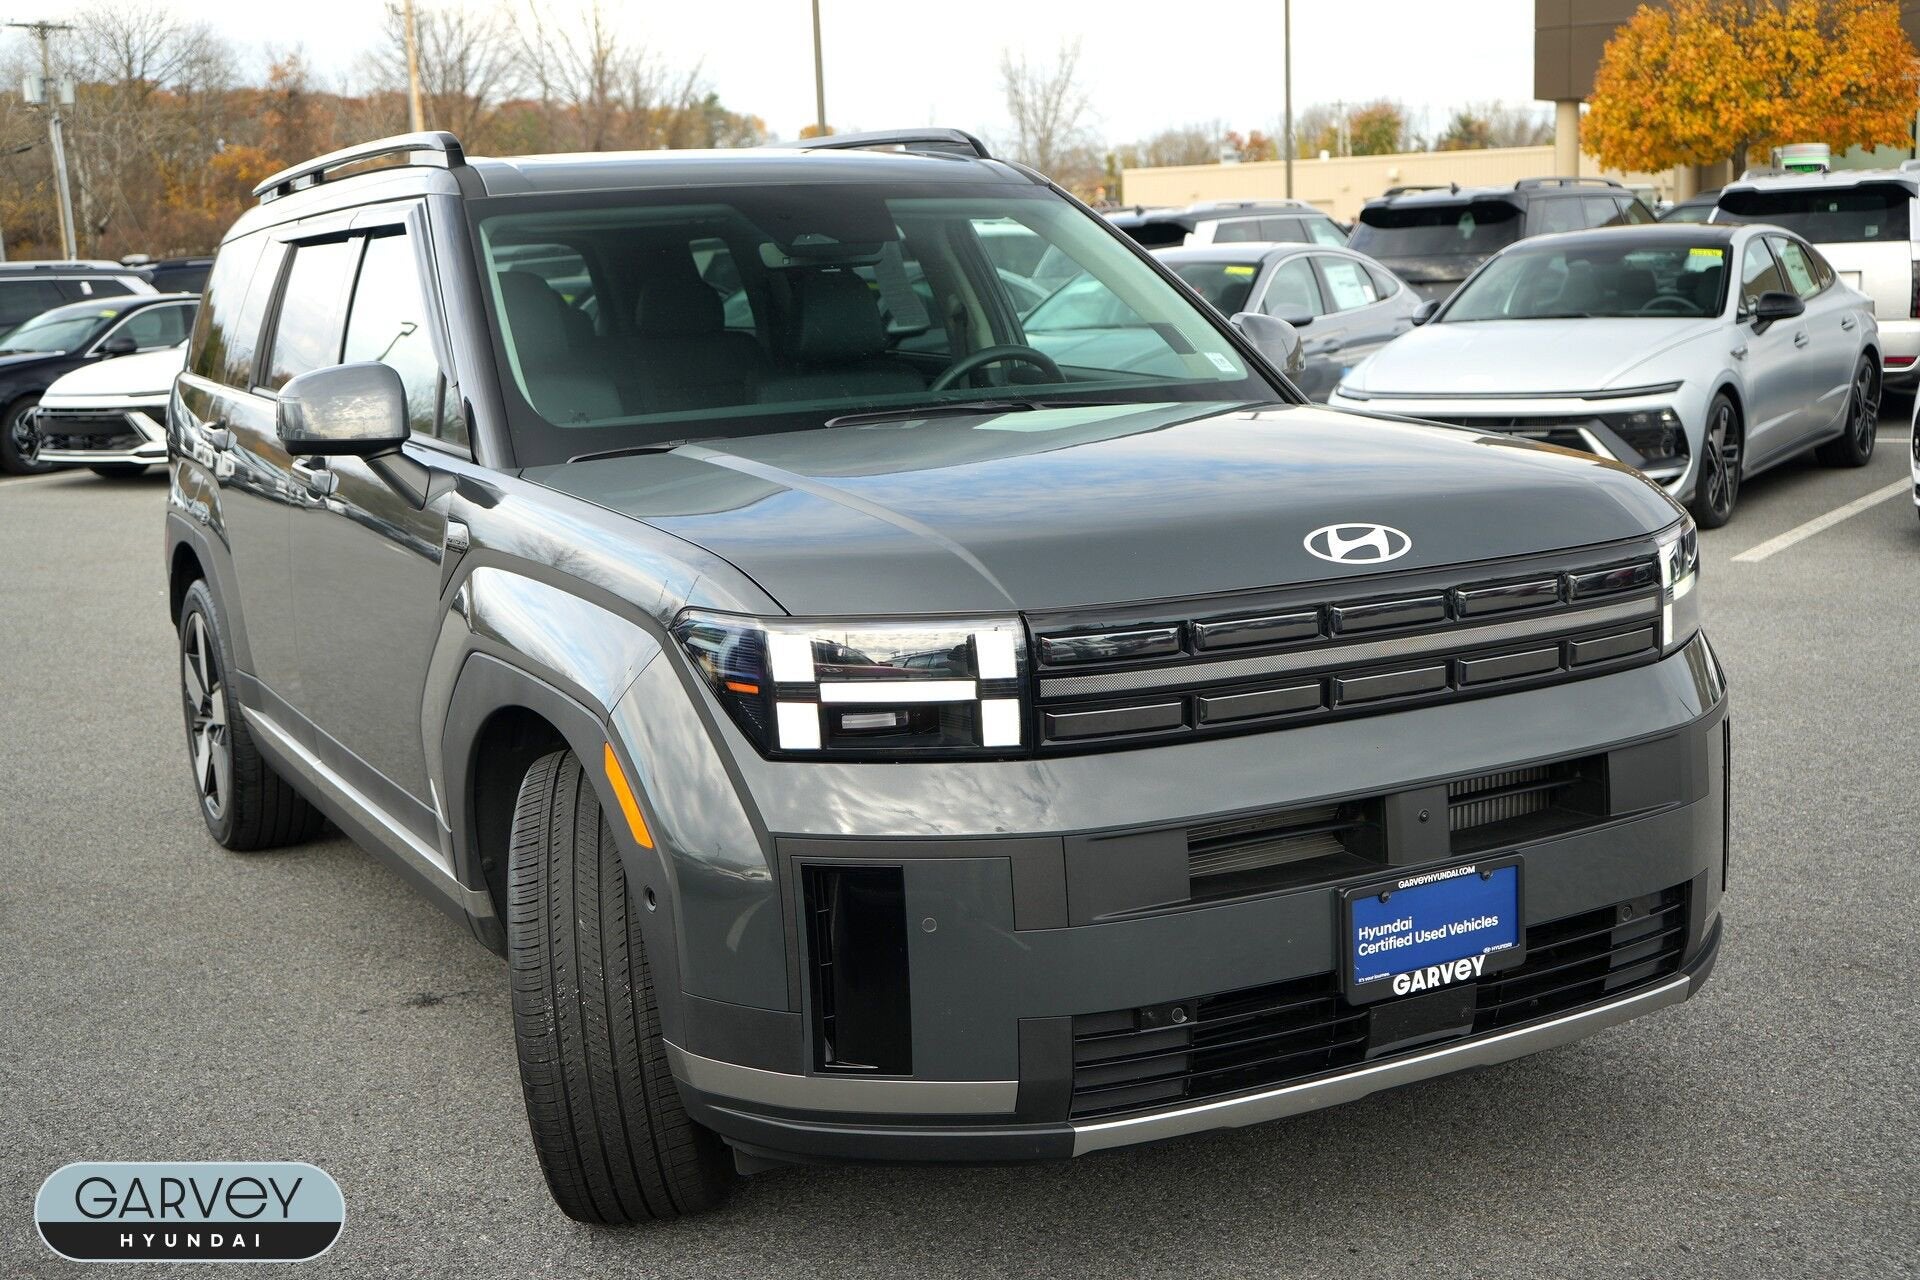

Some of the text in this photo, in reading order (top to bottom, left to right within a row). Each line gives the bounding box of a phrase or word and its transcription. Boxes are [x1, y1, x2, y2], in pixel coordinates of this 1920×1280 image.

[1358, 916, 1412, 941] Hyundai
[1358, 915, 1499, 957] Certified Used Vehicles
[1392, 954, 1486, 996] GARVEY
